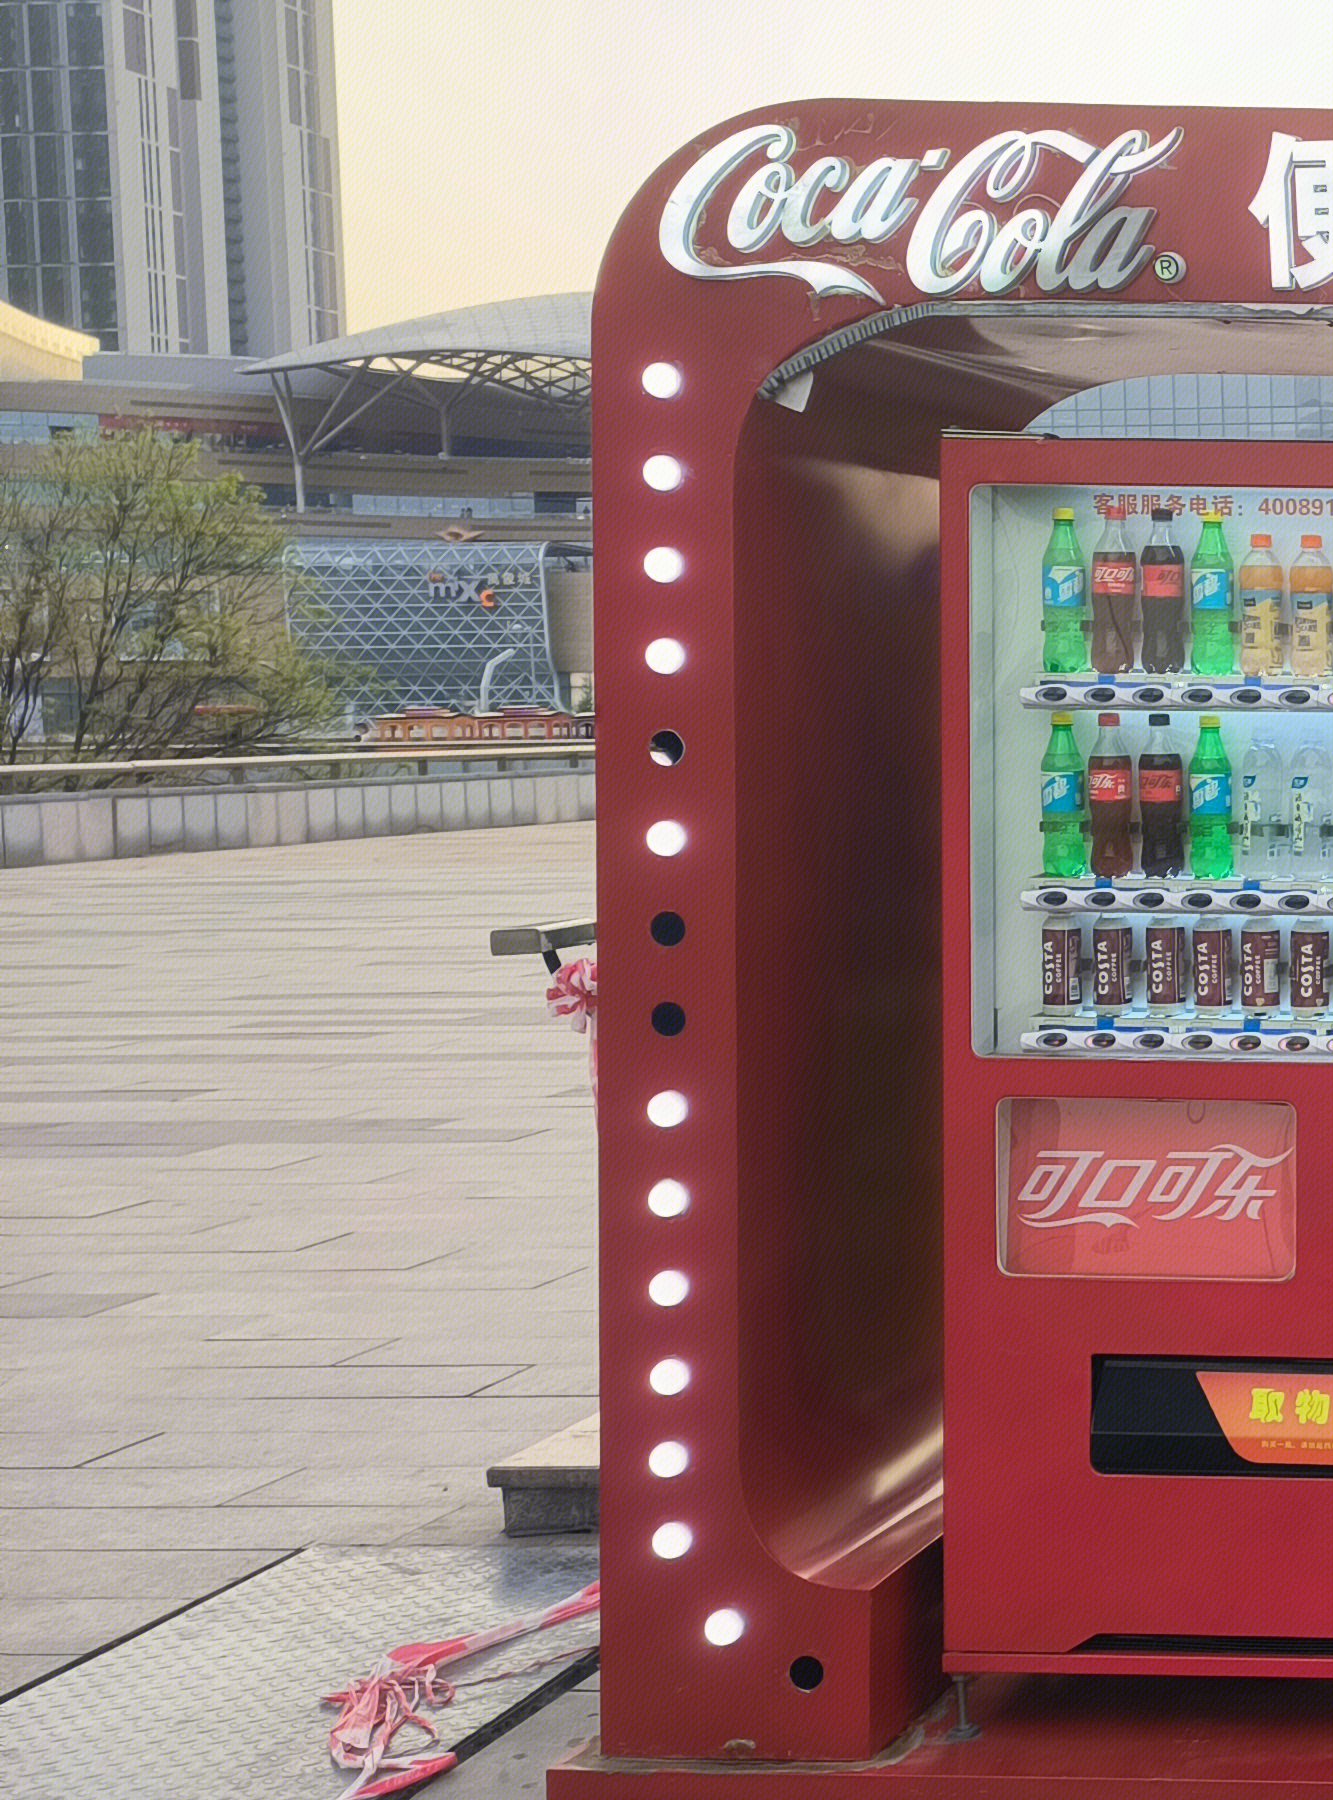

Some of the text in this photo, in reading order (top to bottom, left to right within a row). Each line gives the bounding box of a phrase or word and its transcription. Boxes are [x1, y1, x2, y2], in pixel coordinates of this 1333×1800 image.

[658, 124, 1184, 303] Coca-Cola
[1044, 941, 1053, 995] COSTA
[1097, 941, 1109, 995] COSTA
[1151, 940, 1163, 993] COSTA
[1197, 942, 1209, 996] COSTA
[1243, 943, 1252, 996] COSTA
[1301, 943, 1314, 997] COSTA
[1017, 1143, 1294, 1229] 可口可乐
